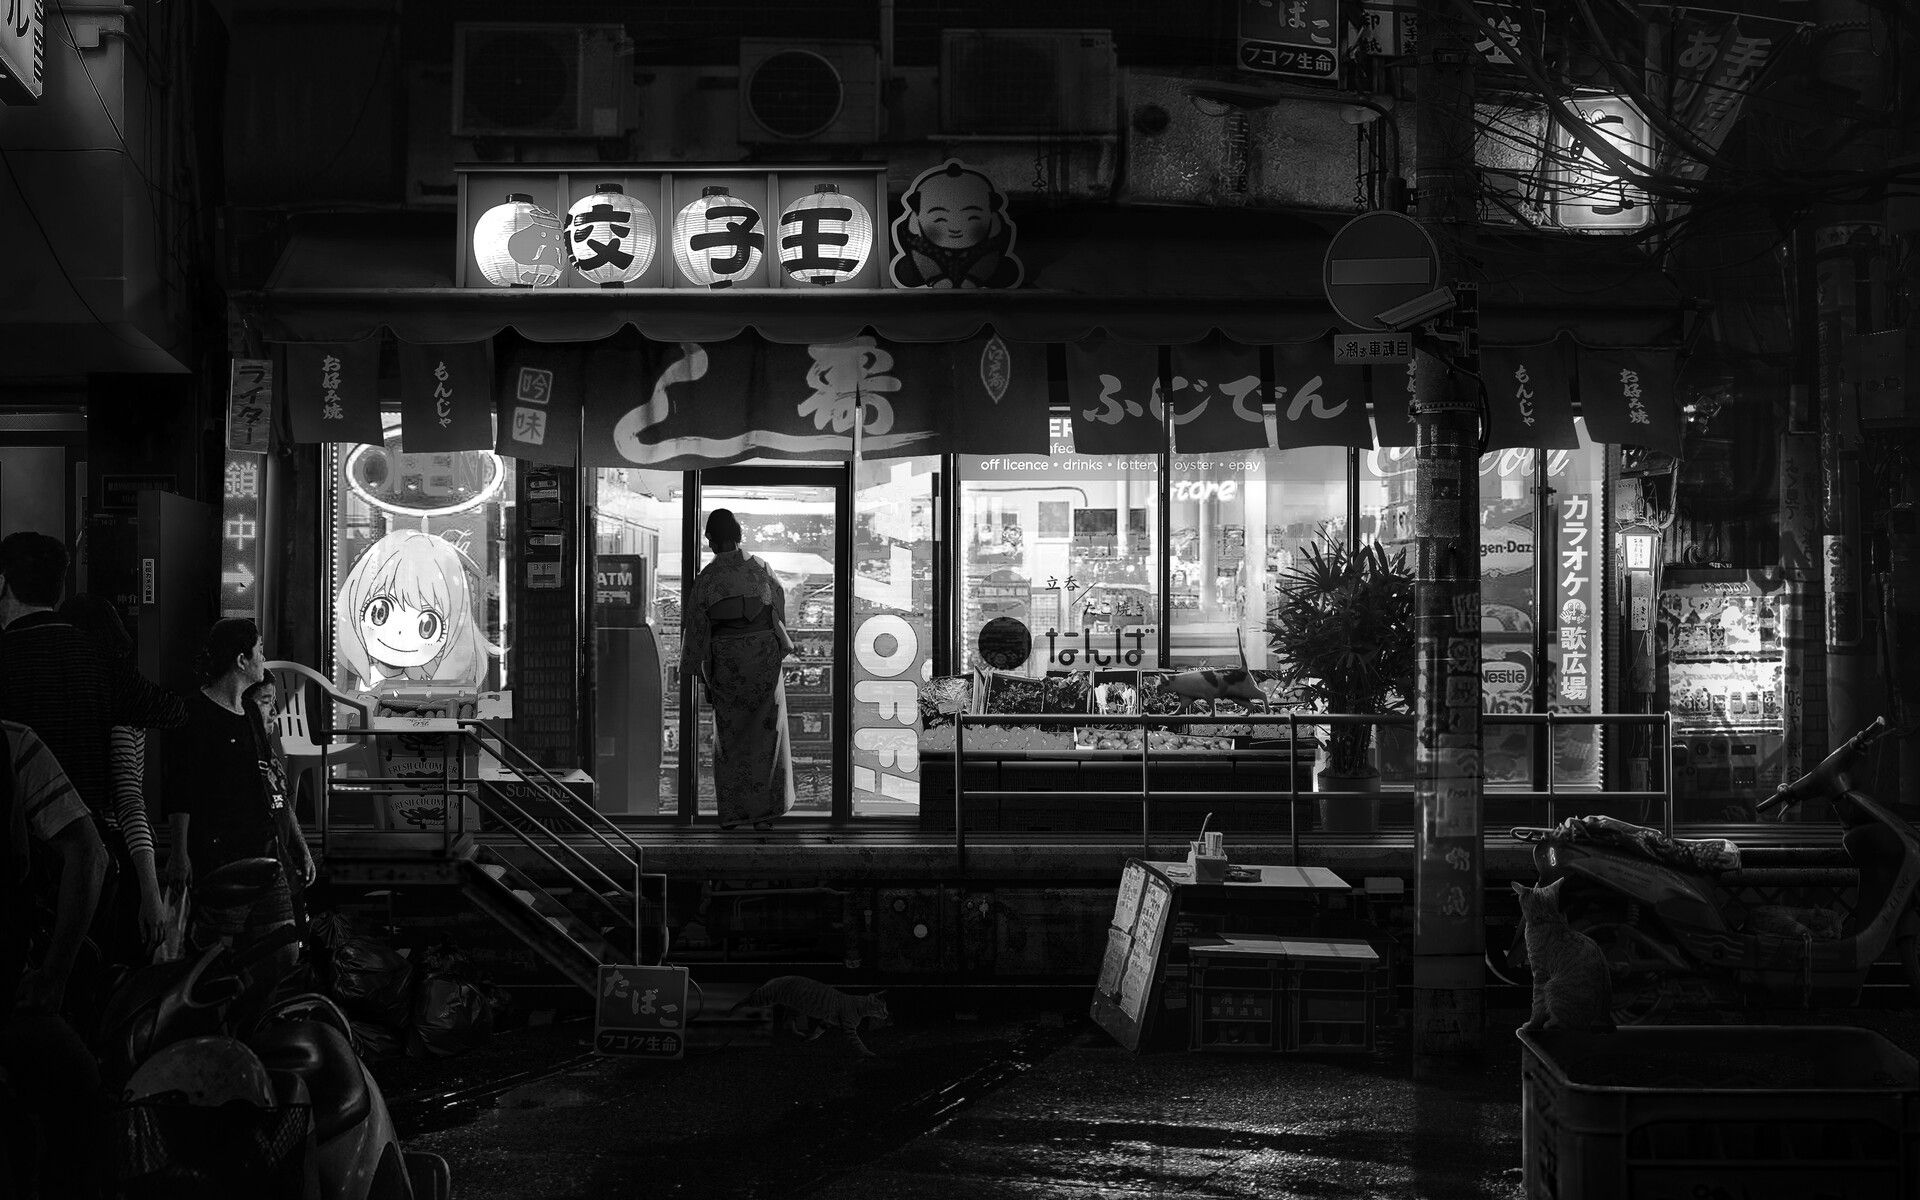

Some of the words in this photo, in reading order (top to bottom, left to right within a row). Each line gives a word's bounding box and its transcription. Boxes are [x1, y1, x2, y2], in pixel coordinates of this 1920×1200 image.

[1259, 0, 1332, 45] ばこ
[239, 364, 266, 446] ライター
[322, 354, 344, 420] お好み焼
[432, 361, 453, 429] もんじゃ
[1514, 364, 1536, 427] もんじゃ
[1620, 368, 1651, 425] お好み焼
[980, 458, 1000, 471] off
[1003, 458, 1049, 471] licence
[1063, 458, 1103, 471] drinks
[1117, 458, 1158, 474] lottery
[1174, 460, 1215, 473] oyster
[1228, 461, 1260, 473] epay
[1561, 495, 1589, 597] カラオケ
[597, 571, 633, 586] ATM
[1045, 575, 1081, 592] 立呑
[1083, 601, 1145, 617] たこ焼き
[1560, 626, 1588, 700] 歌広場
[414, 761, 458, 775] CUCUMER
[415, 798, 459, 810] CUCUMER
[603, 969, 679, 1028] たばこ
